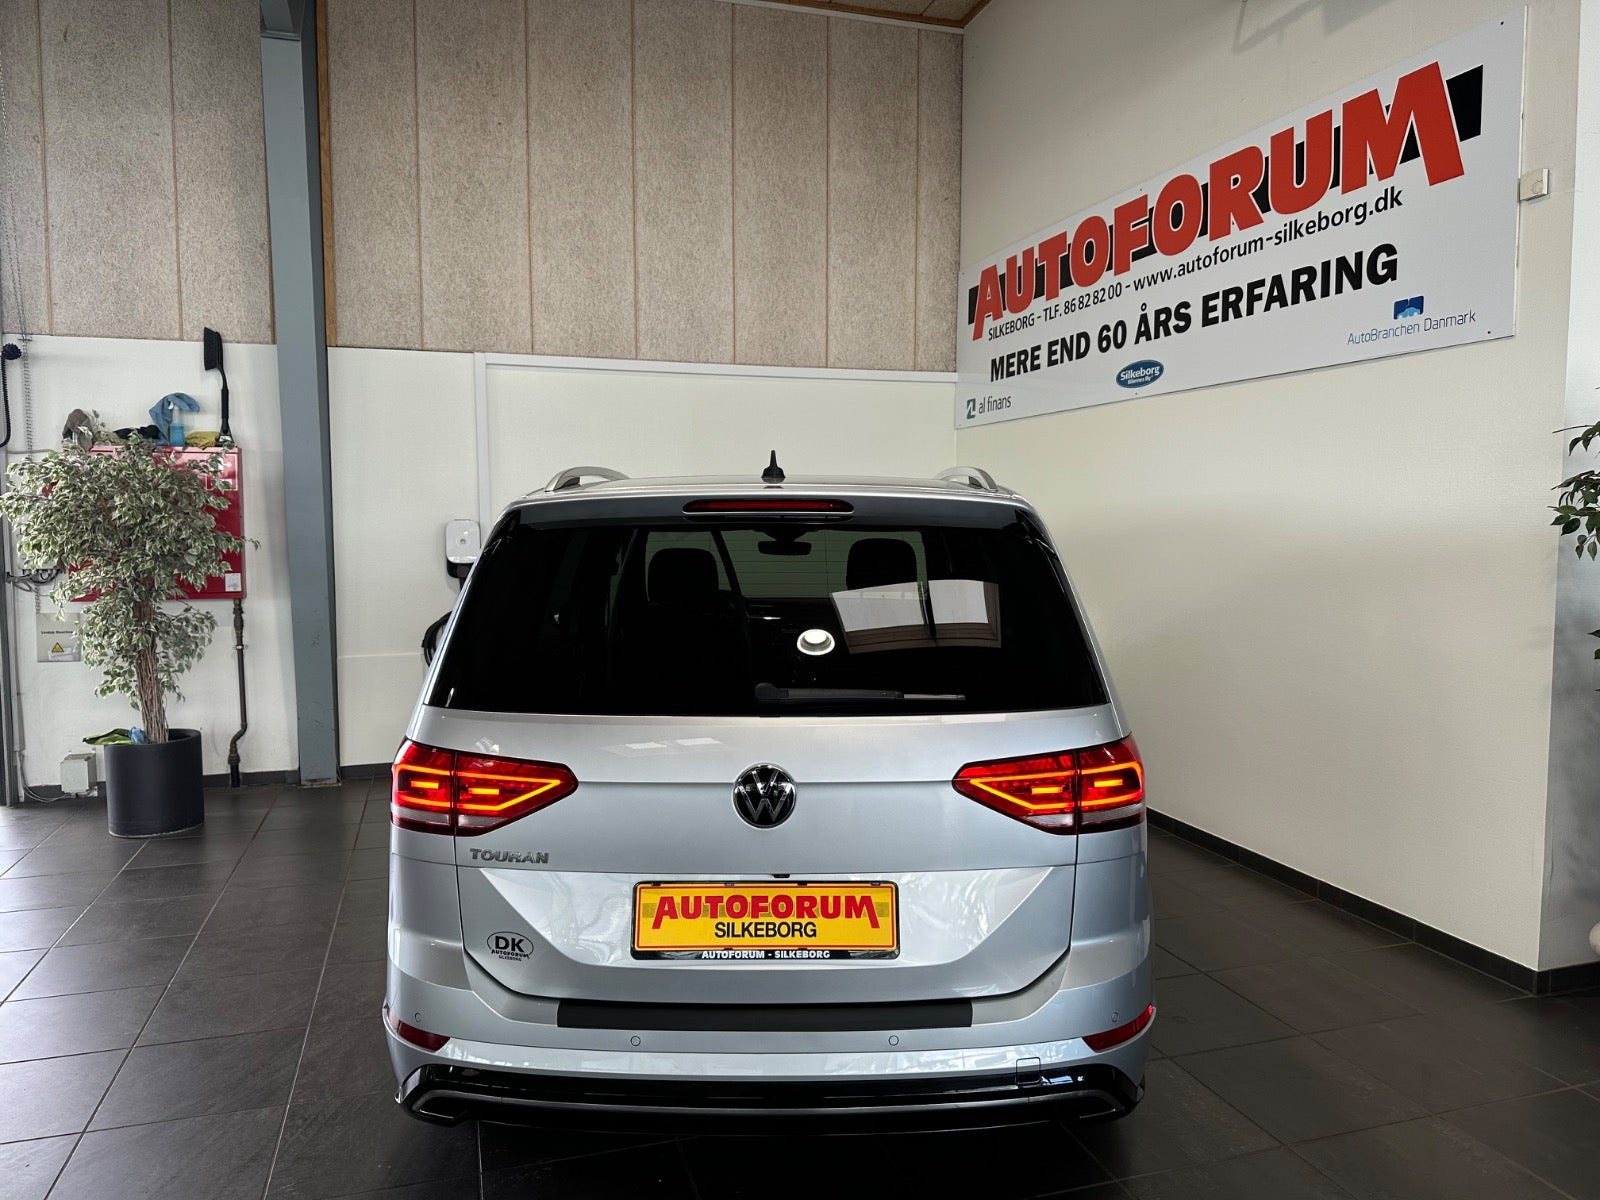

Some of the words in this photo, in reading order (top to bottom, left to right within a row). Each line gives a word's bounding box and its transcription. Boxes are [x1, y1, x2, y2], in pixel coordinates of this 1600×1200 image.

[972, 60, 1465, 341] AUTOFORUM
[988, 313, 1035, 342] SILKEBORG
[1043, 303, 1063, 323] TLF.
[1133, 186, 1403, 292] www.autoforum-silkeborg.dk
[990, 344, 1042, 382] MERE
[1047, 331, 1091, 368] END
[1097, 319, 1127, 354] 60
[1134, 302, 1192, 345] ÅRS
[1201, 243, 1399, 328] ERFARING
[1347, 322, 1420, 346] AutoBranchen
[1424, 309, 1476, 332] Danmark
[1120, 365, 1161, 381] Silkeborg
[987, 395, 1012, 412] finans
[469, 847, 550, 865] TOURAN
[651, 894, 881, 930] AUTOFORUM
[714, 921, 817, 939] SILKEBORG
[495, 935, 525, 953] DK
[701, 950, 765, 959] AUTOFORUM
[774, 950, 830, 959] SILKEBORG
